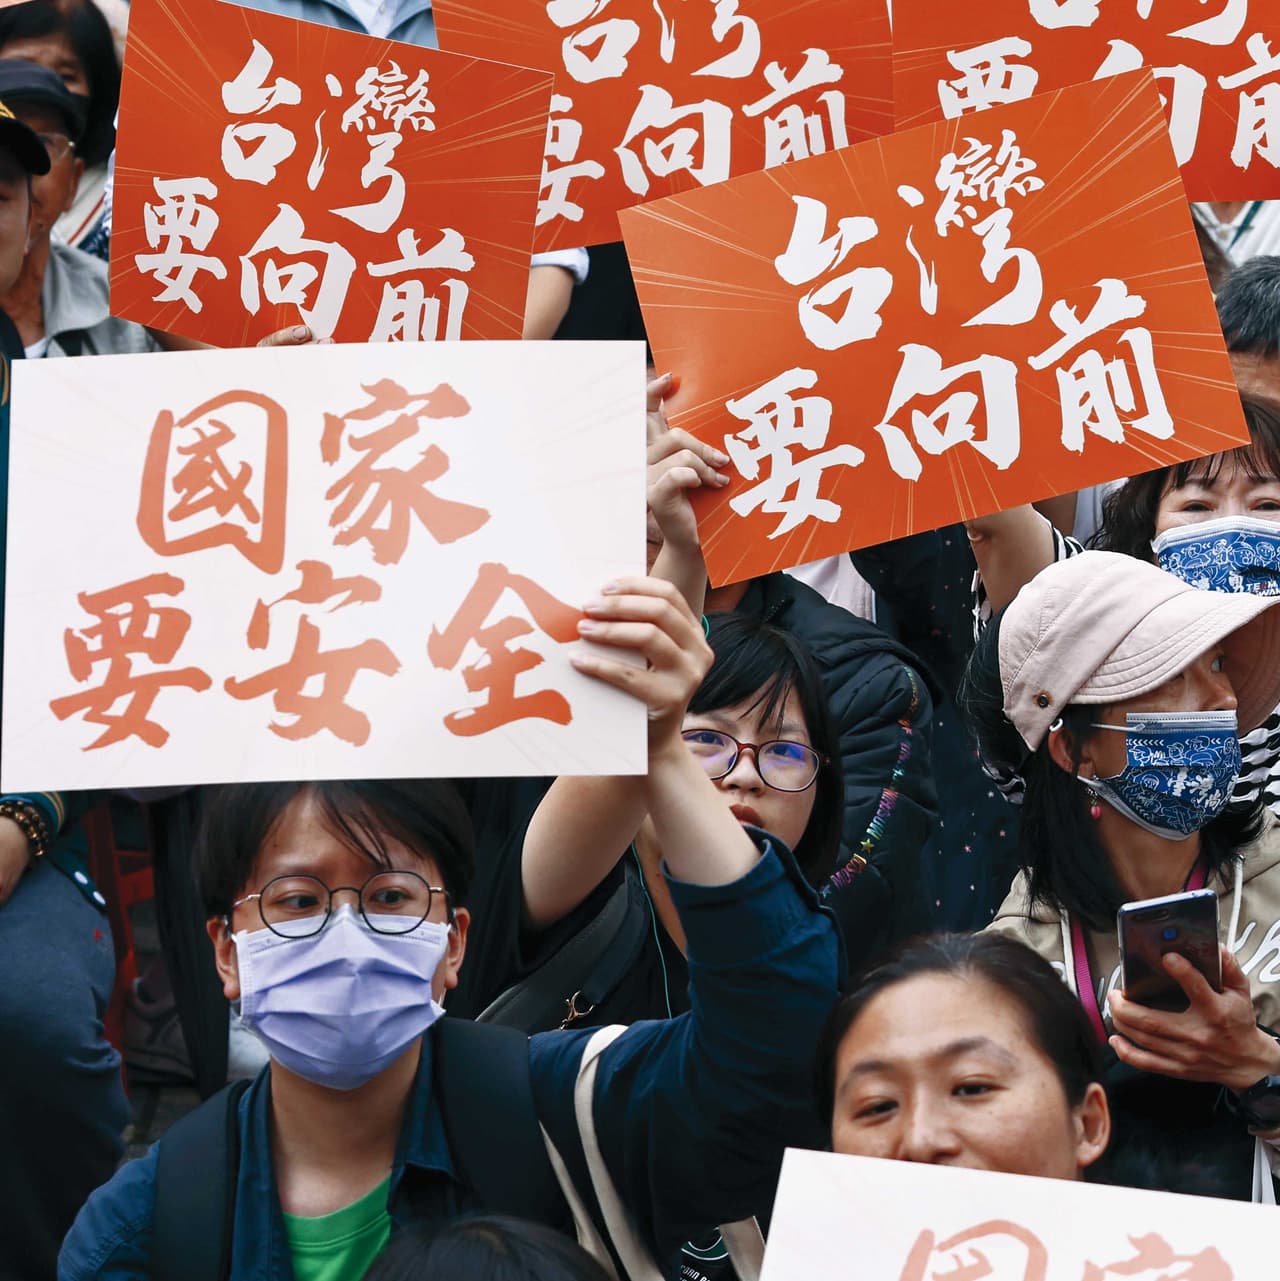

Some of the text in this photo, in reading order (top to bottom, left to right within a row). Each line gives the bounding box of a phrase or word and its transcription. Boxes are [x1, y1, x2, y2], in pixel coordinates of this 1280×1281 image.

[220, 38, 436, 233] 台灣
[135, 175, 475, 342] 要向前
[775, 128, 1044, 352] 台灣
[135, 377, 492, 575] 國家
[724, 278, 1176, 540] 要向前
[49, 560, 587, 751] 要安全
